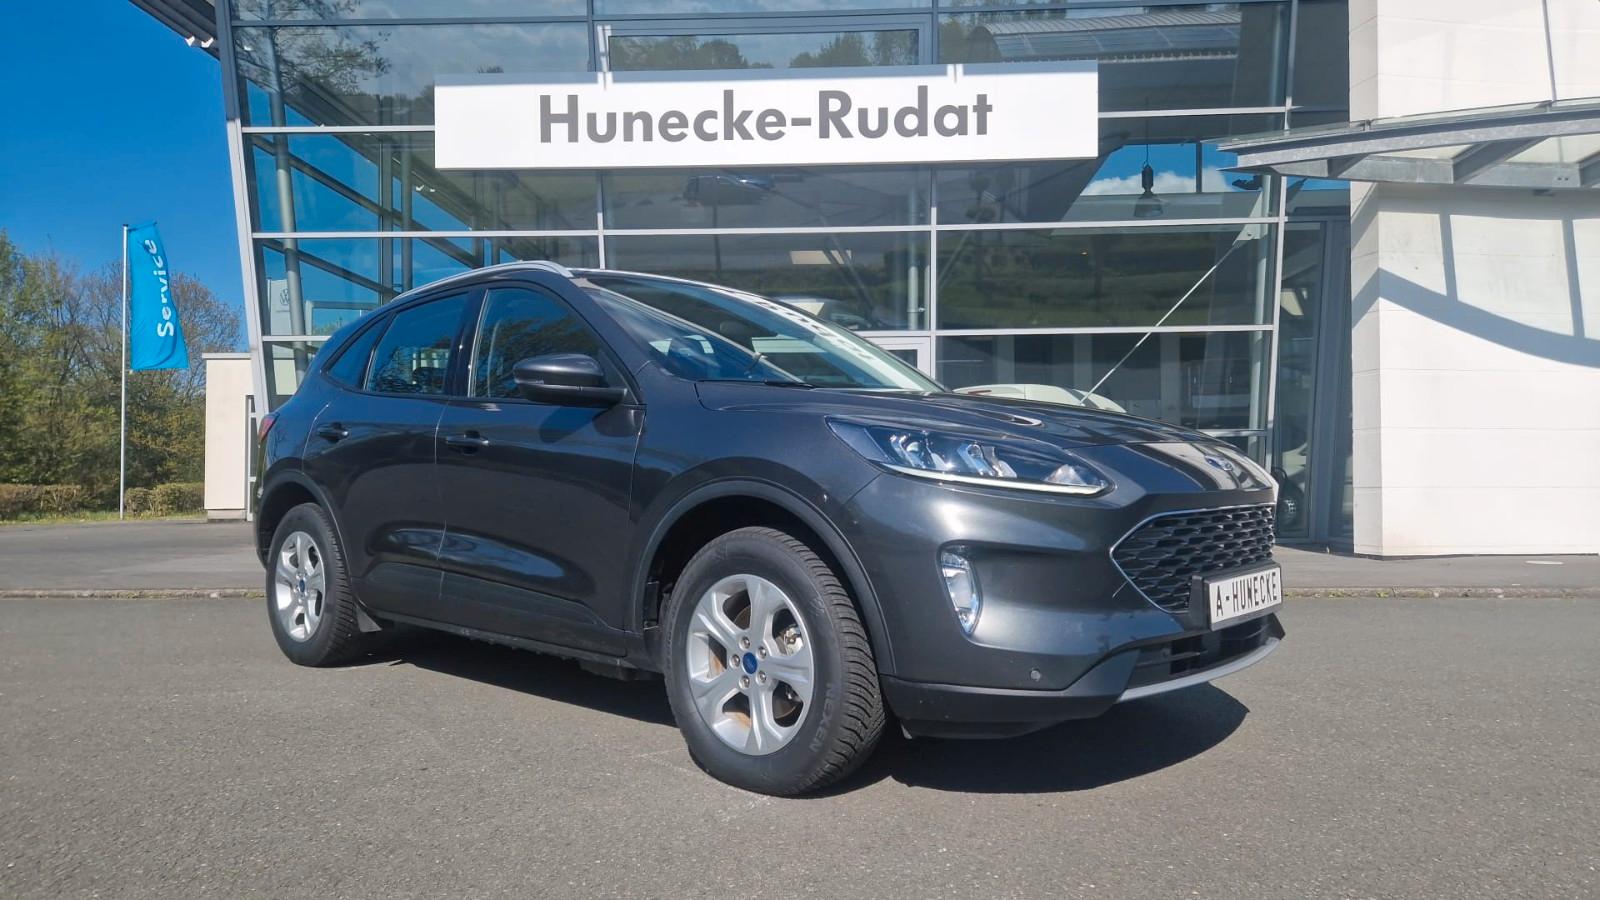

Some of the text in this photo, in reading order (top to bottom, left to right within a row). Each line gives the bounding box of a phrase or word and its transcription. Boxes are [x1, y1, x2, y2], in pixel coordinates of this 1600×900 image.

[540, 85, 993, 144] Hunecke-Rudat
[144, 239, 174, 337] Service
[1216, 571, 1278, 617] A-HUNECKE
